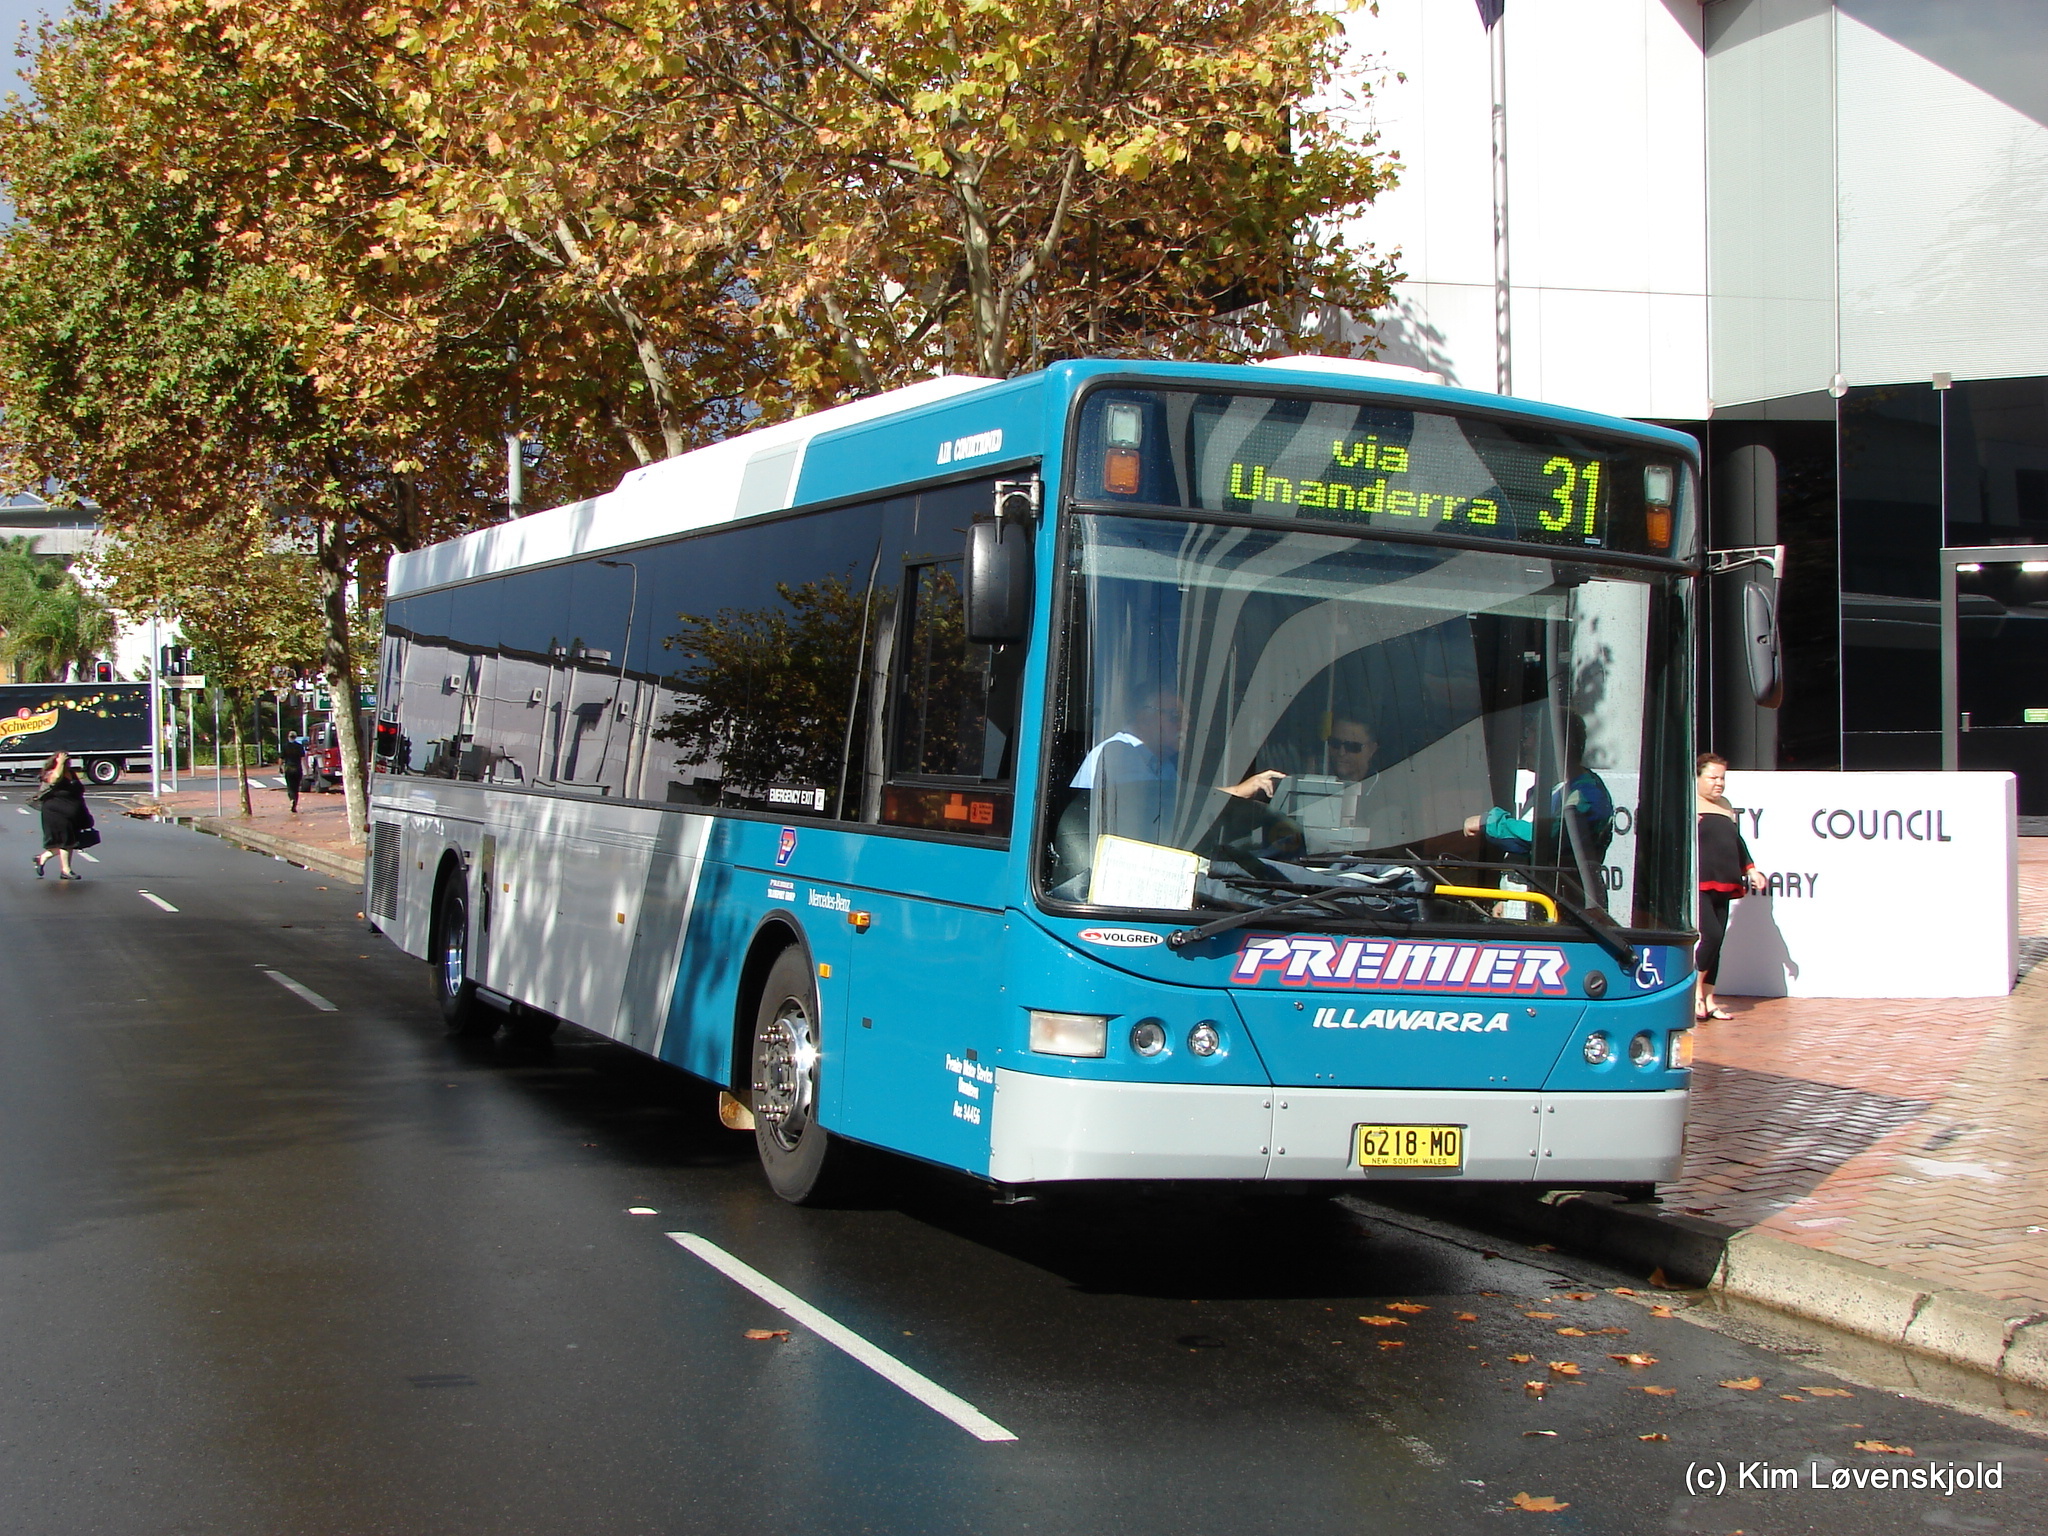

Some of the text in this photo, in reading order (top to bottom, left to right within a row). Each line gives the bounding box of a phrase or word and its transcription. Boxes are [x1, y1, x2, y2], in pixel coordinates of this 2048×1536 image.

[1333, 435, 1409, 473] via
[1230, 463, 1498, 526] Unanderra
[1539, 456, 1600, 534] 31
[0, 718, 52, 737] Schweppes
[1811, 808, 1951, 842] COUNCIL
[808, 888, 851, 912] Mercedes-Benz
[1103, 932, 1158, 943] VOLGREN
[1233, 934, 1568, 993] PREMIER
[1313, 1007, 1508, 1033] ILLAWARRA
